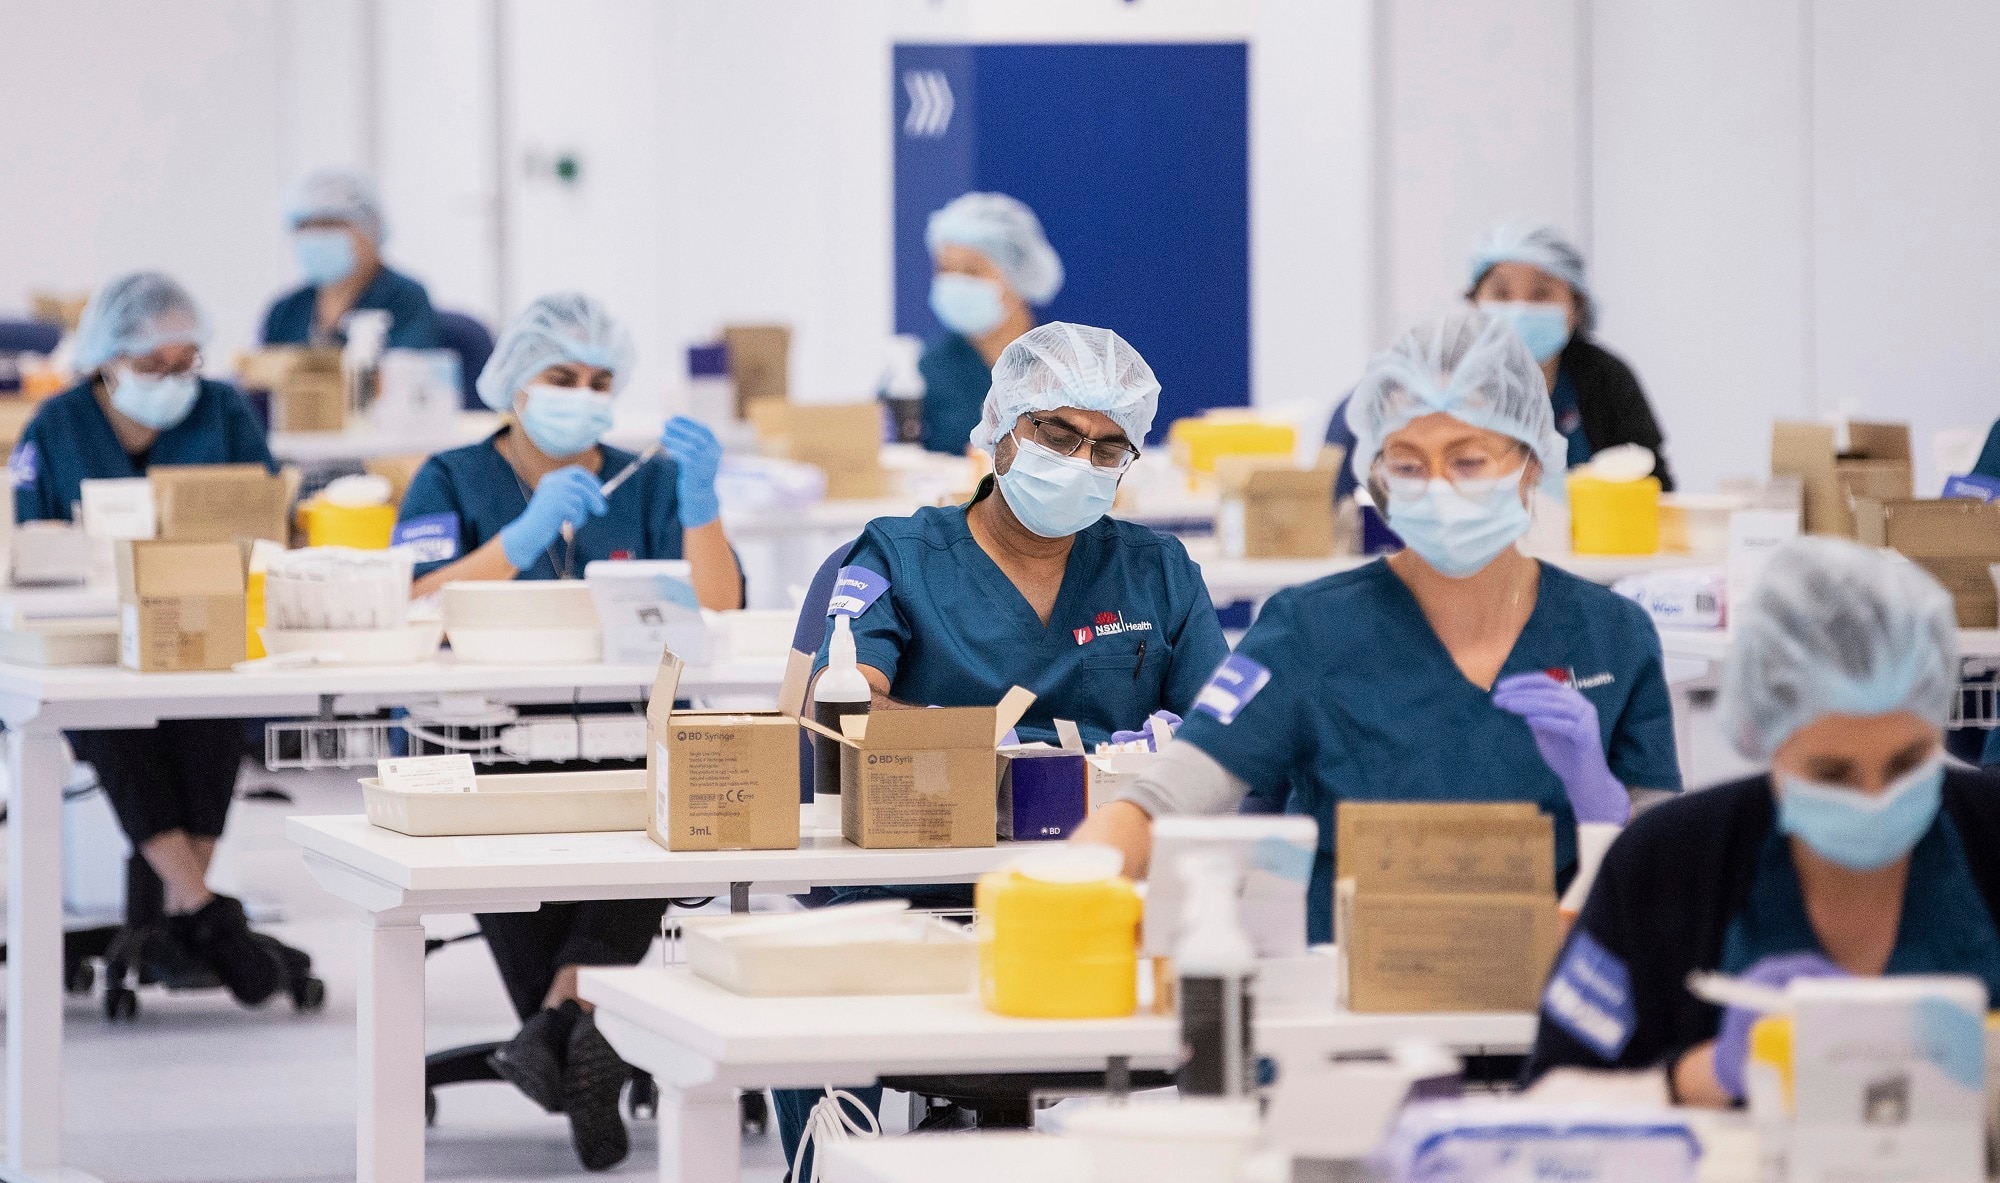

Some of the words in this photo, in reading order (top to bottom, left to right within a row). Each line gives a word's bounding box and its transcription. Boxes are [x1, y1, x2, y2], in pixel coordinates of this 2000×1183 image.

[1095, 622, 1121, 635] NSW
[1125, 621, 1153, 632] Health
[1577, 672, 1616, 689] Health
[688, 732, 702, 740] BD
[704, 732, 735, 742] Syringe
[879, 755, 893, 764] BD
[690, 826, 712, 836] 3mL
